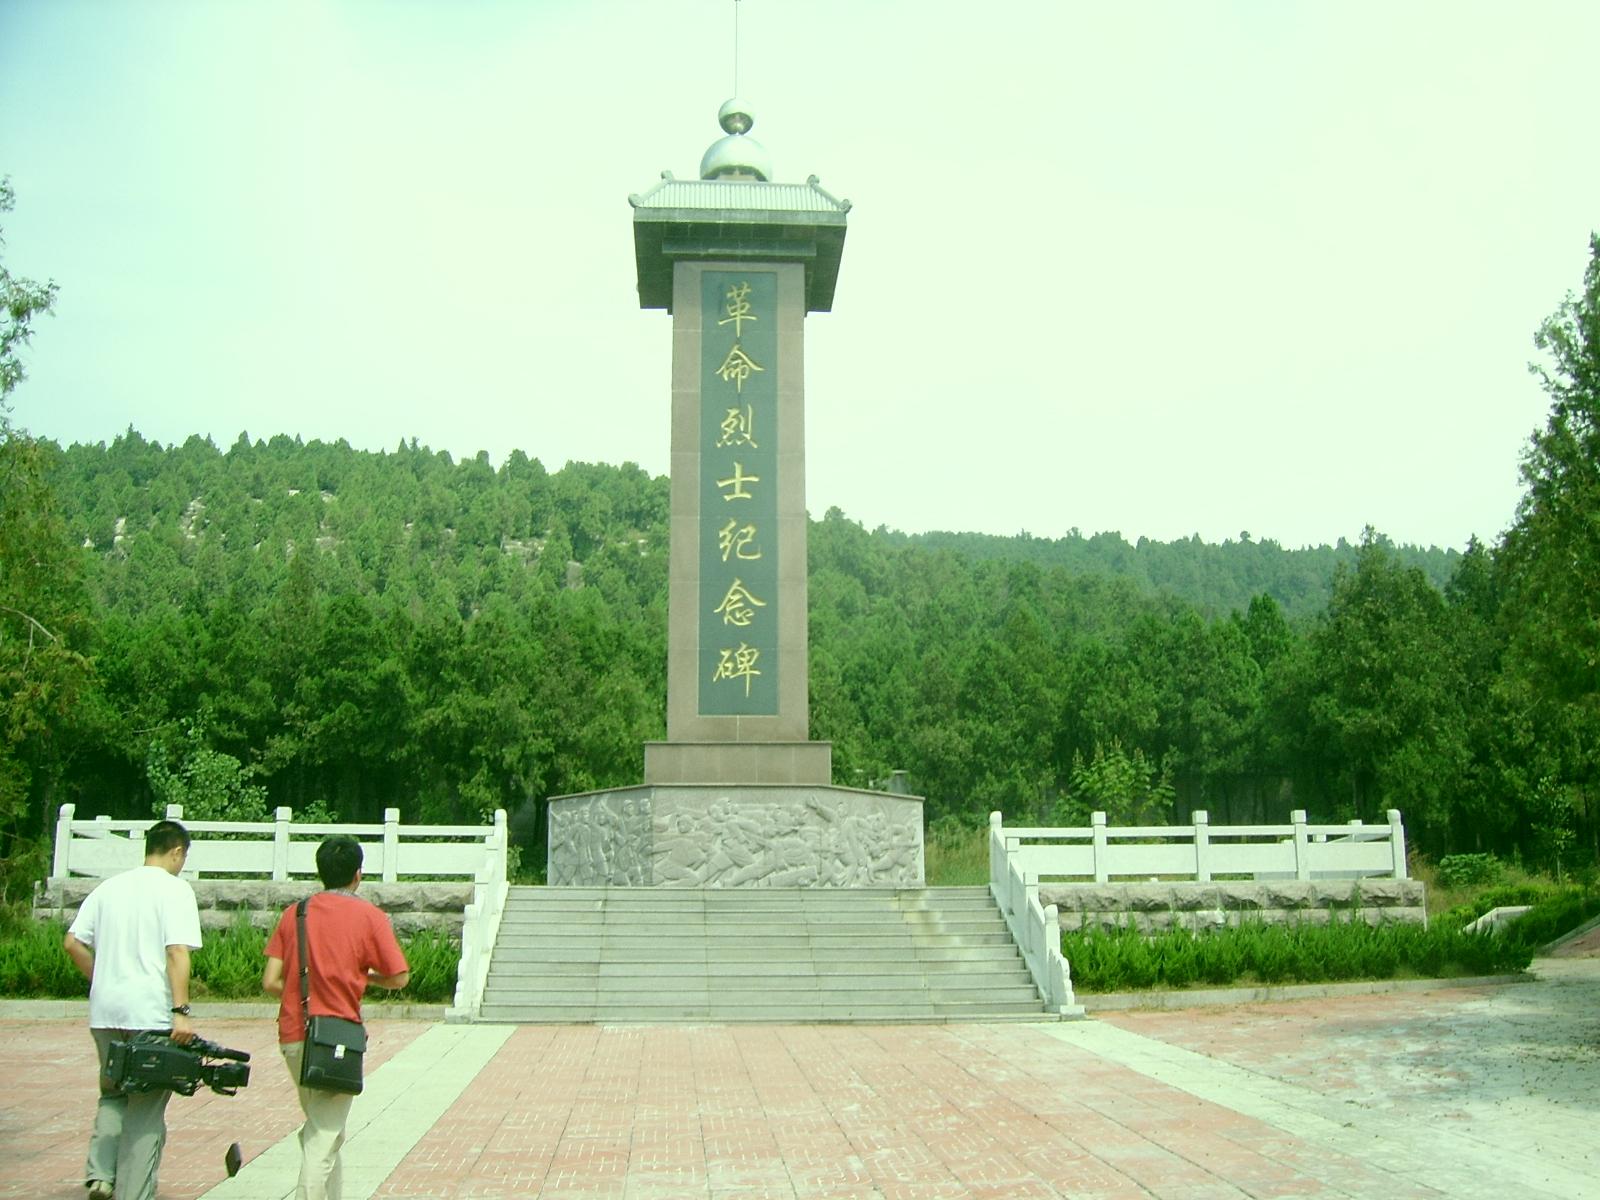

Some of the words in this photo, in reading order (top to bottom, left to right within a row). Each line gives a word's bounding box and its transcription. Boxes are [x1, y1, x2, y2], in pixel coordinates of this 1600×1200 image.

[713, 281, 767, 698] 革命烈士纪念碑
